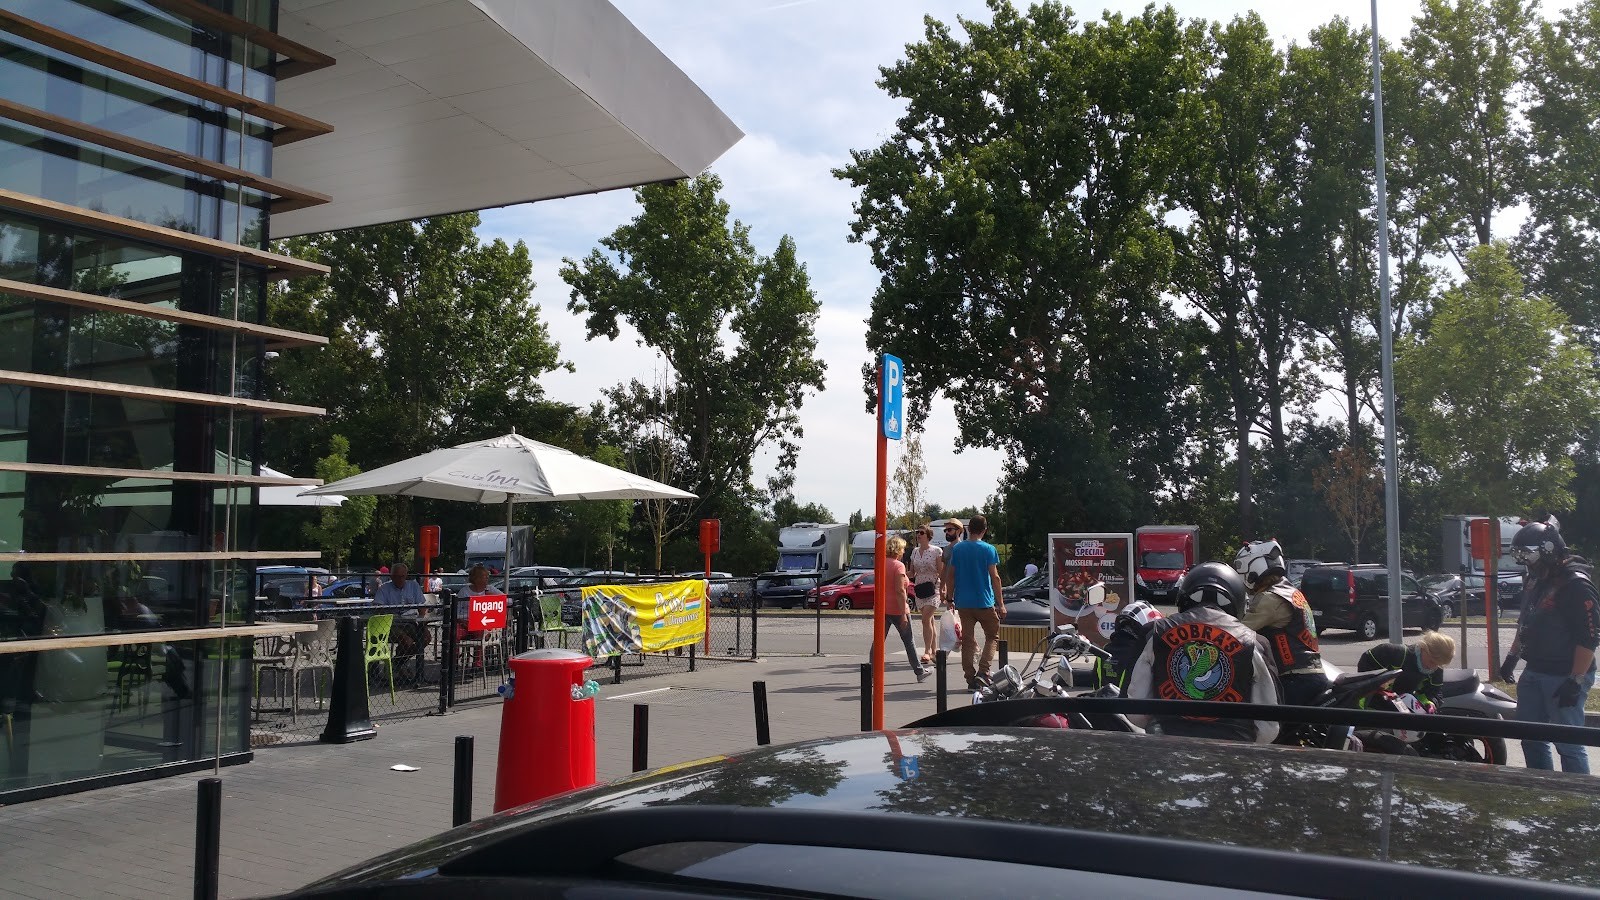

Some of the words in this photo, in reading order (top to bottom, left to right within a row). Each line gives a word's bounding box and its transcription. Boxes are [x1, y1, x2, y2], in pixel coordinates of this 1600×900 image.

[888, 360, 900, 404] P
[1081, 540, 1100, 548] CHEF'S
[1075, 548, 1105, 556] SPECIAL
[1065, 559, 1093, 567] MOSSELEN
[1098, 572, 1115, 581] Prins
[472, 599, 504, 614] Ingang
[1165, 624, 1238, 652] COBRA'S
